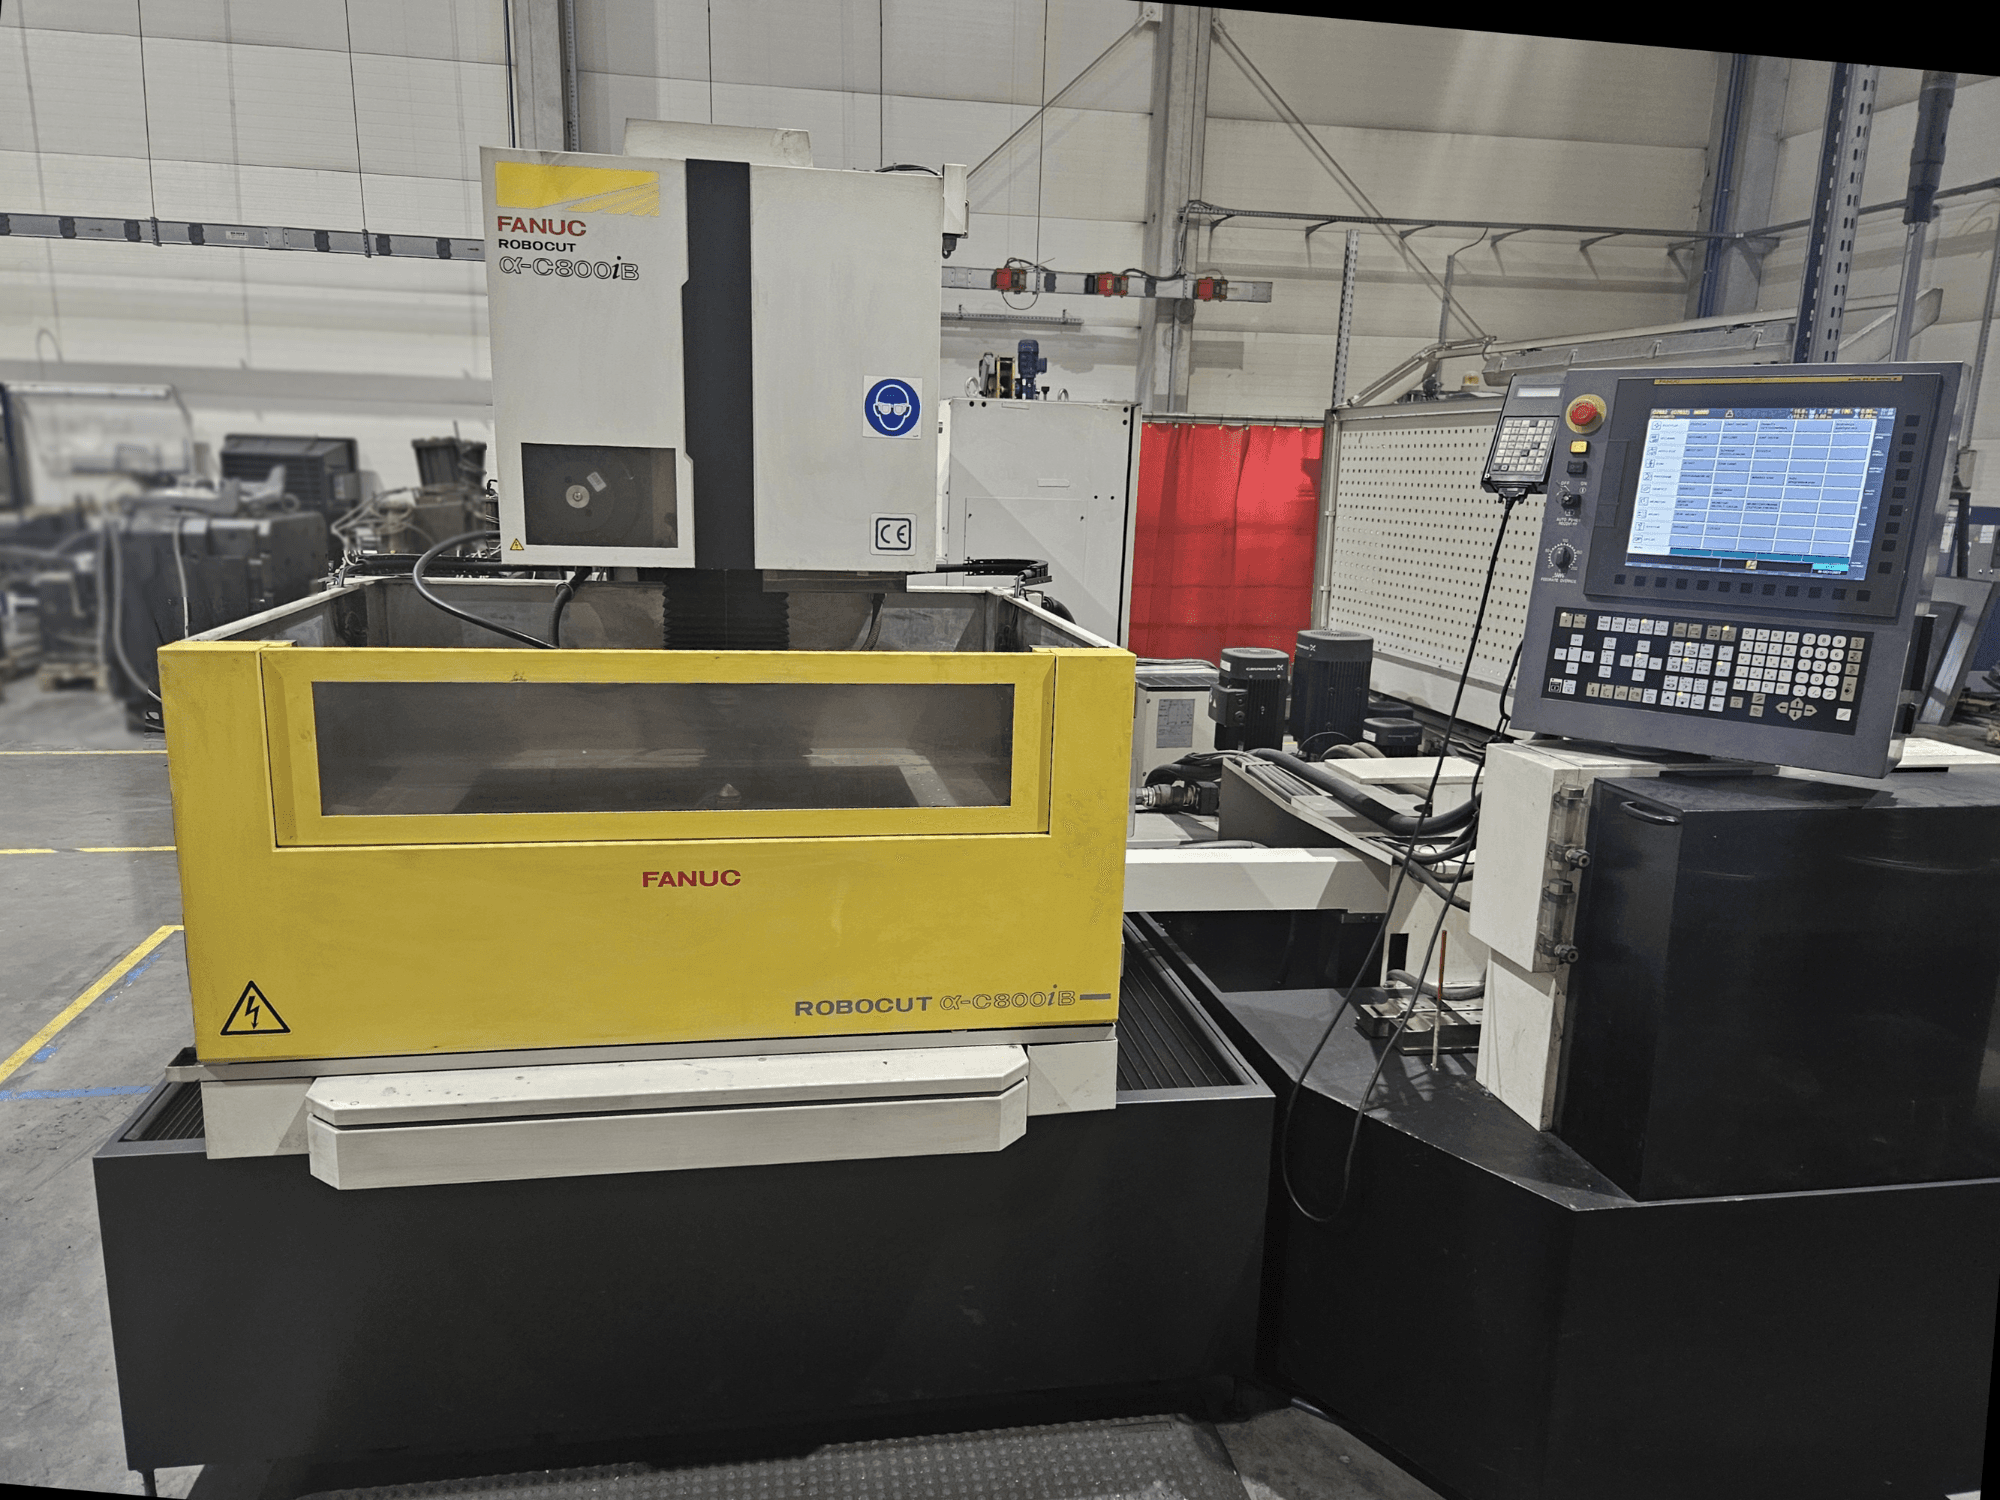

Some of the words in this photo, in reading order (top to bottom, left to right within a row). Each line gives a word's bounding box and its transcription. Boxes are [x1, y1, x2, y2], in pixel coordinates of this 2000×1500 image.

[497, 216, 587, 237] FANUC
[498, 239, 576, 252] ROBOCUT
[880, 524, 907, 544] CE
[642, 869, 741, 888] FANUC
[795, 996, 933, 1016] ROBOCUT
